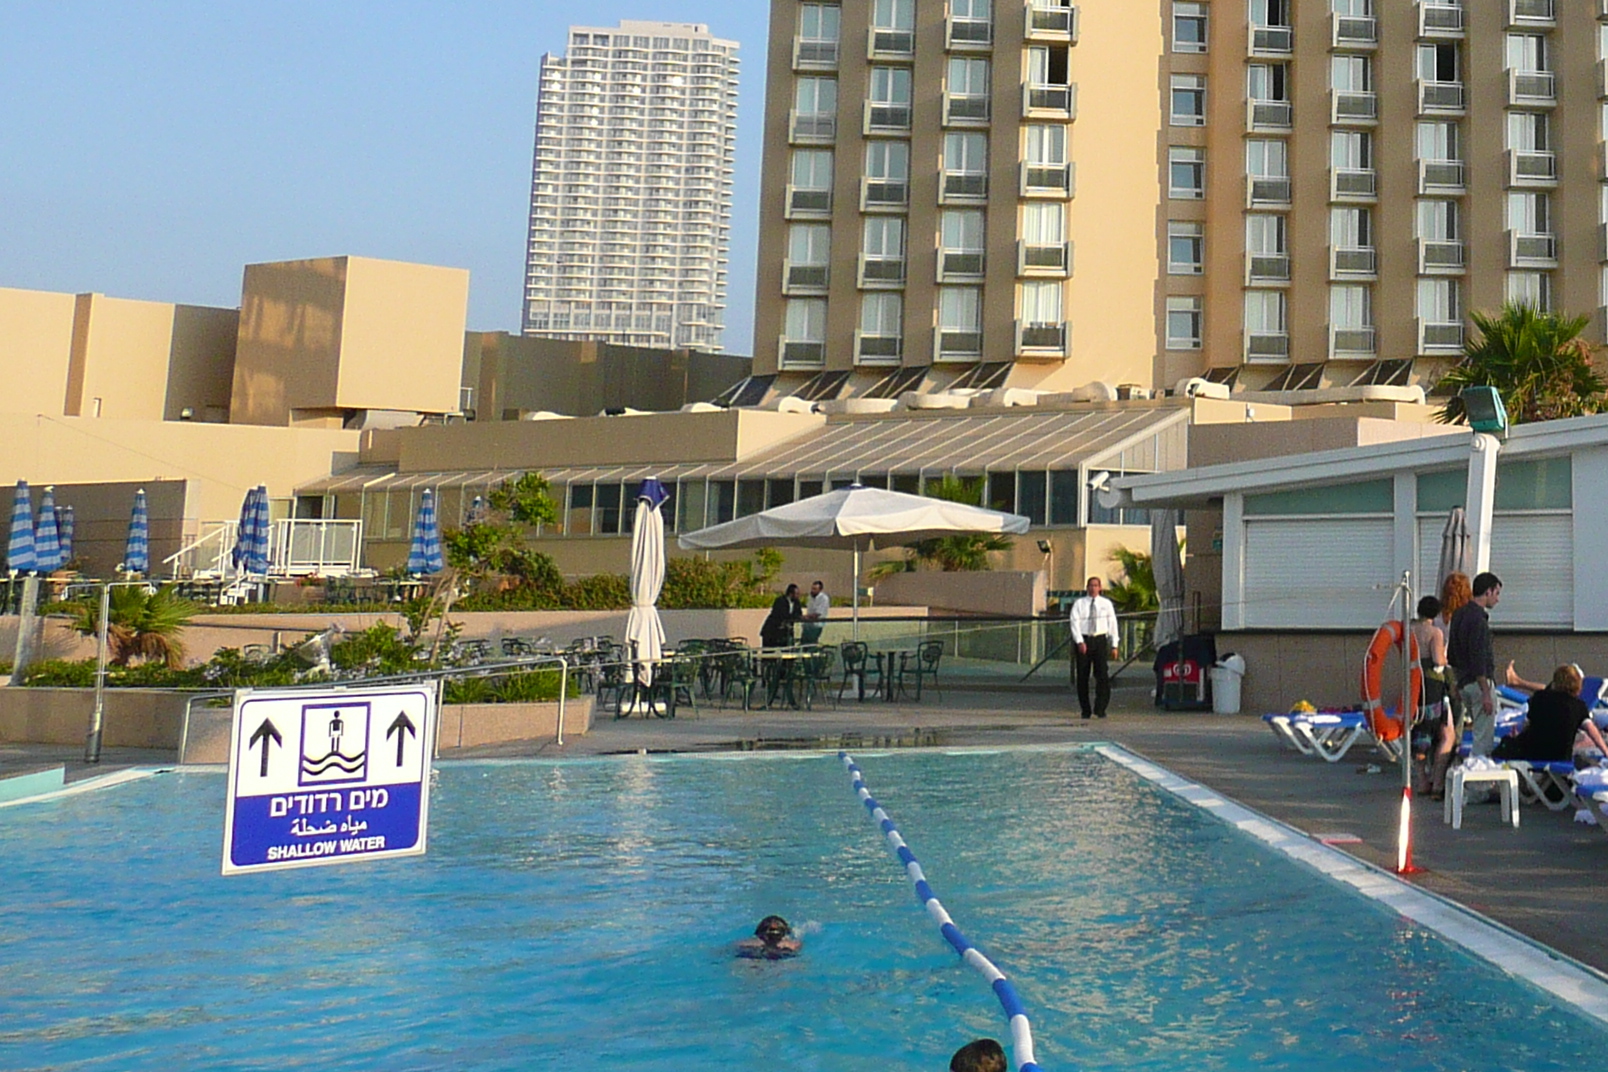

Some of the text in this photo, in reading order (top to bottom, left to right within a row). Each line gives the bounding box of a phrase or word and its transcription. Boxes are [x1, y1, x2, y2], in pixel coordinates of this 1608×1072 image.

[270, 788, 388, 817] מים רדודים
[290, 814, 367, 836] مياه ضحلة
[267, 836, 385, 860] SHALLOW WATER
